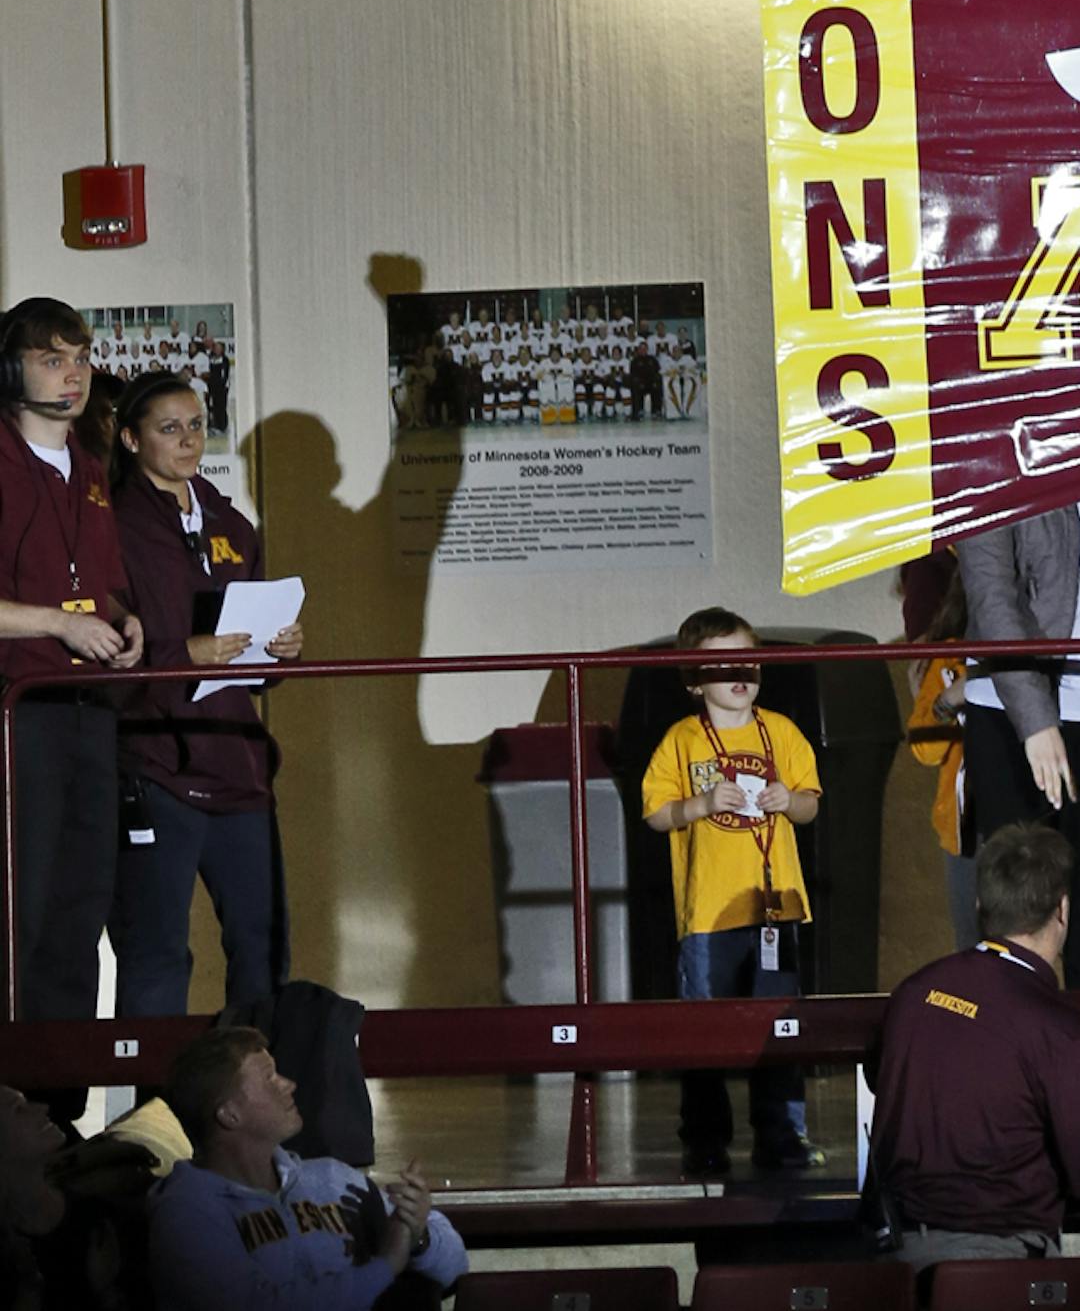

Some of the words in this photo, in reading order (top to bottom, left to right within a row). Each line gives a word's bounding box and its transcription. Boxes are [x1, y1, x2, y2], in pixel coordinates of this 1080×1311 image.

[401, 452, 464, 466] University
[469, 450, 482, 463] of
[485, 448, 550, 462] Minnesota
[554, 445, 612, 459] Women's
[616, 444, 663, 458] Hockey
[667, 442, 701, 455] Team
[519, 463, 583, 477] 2008-2009
[559, 1028, 568, 1041] 3
[781, 1021, 791, 1034] 4
[803, 1289, 815, 1306] 5
[1042, 1284, 1054, 1301] 6
